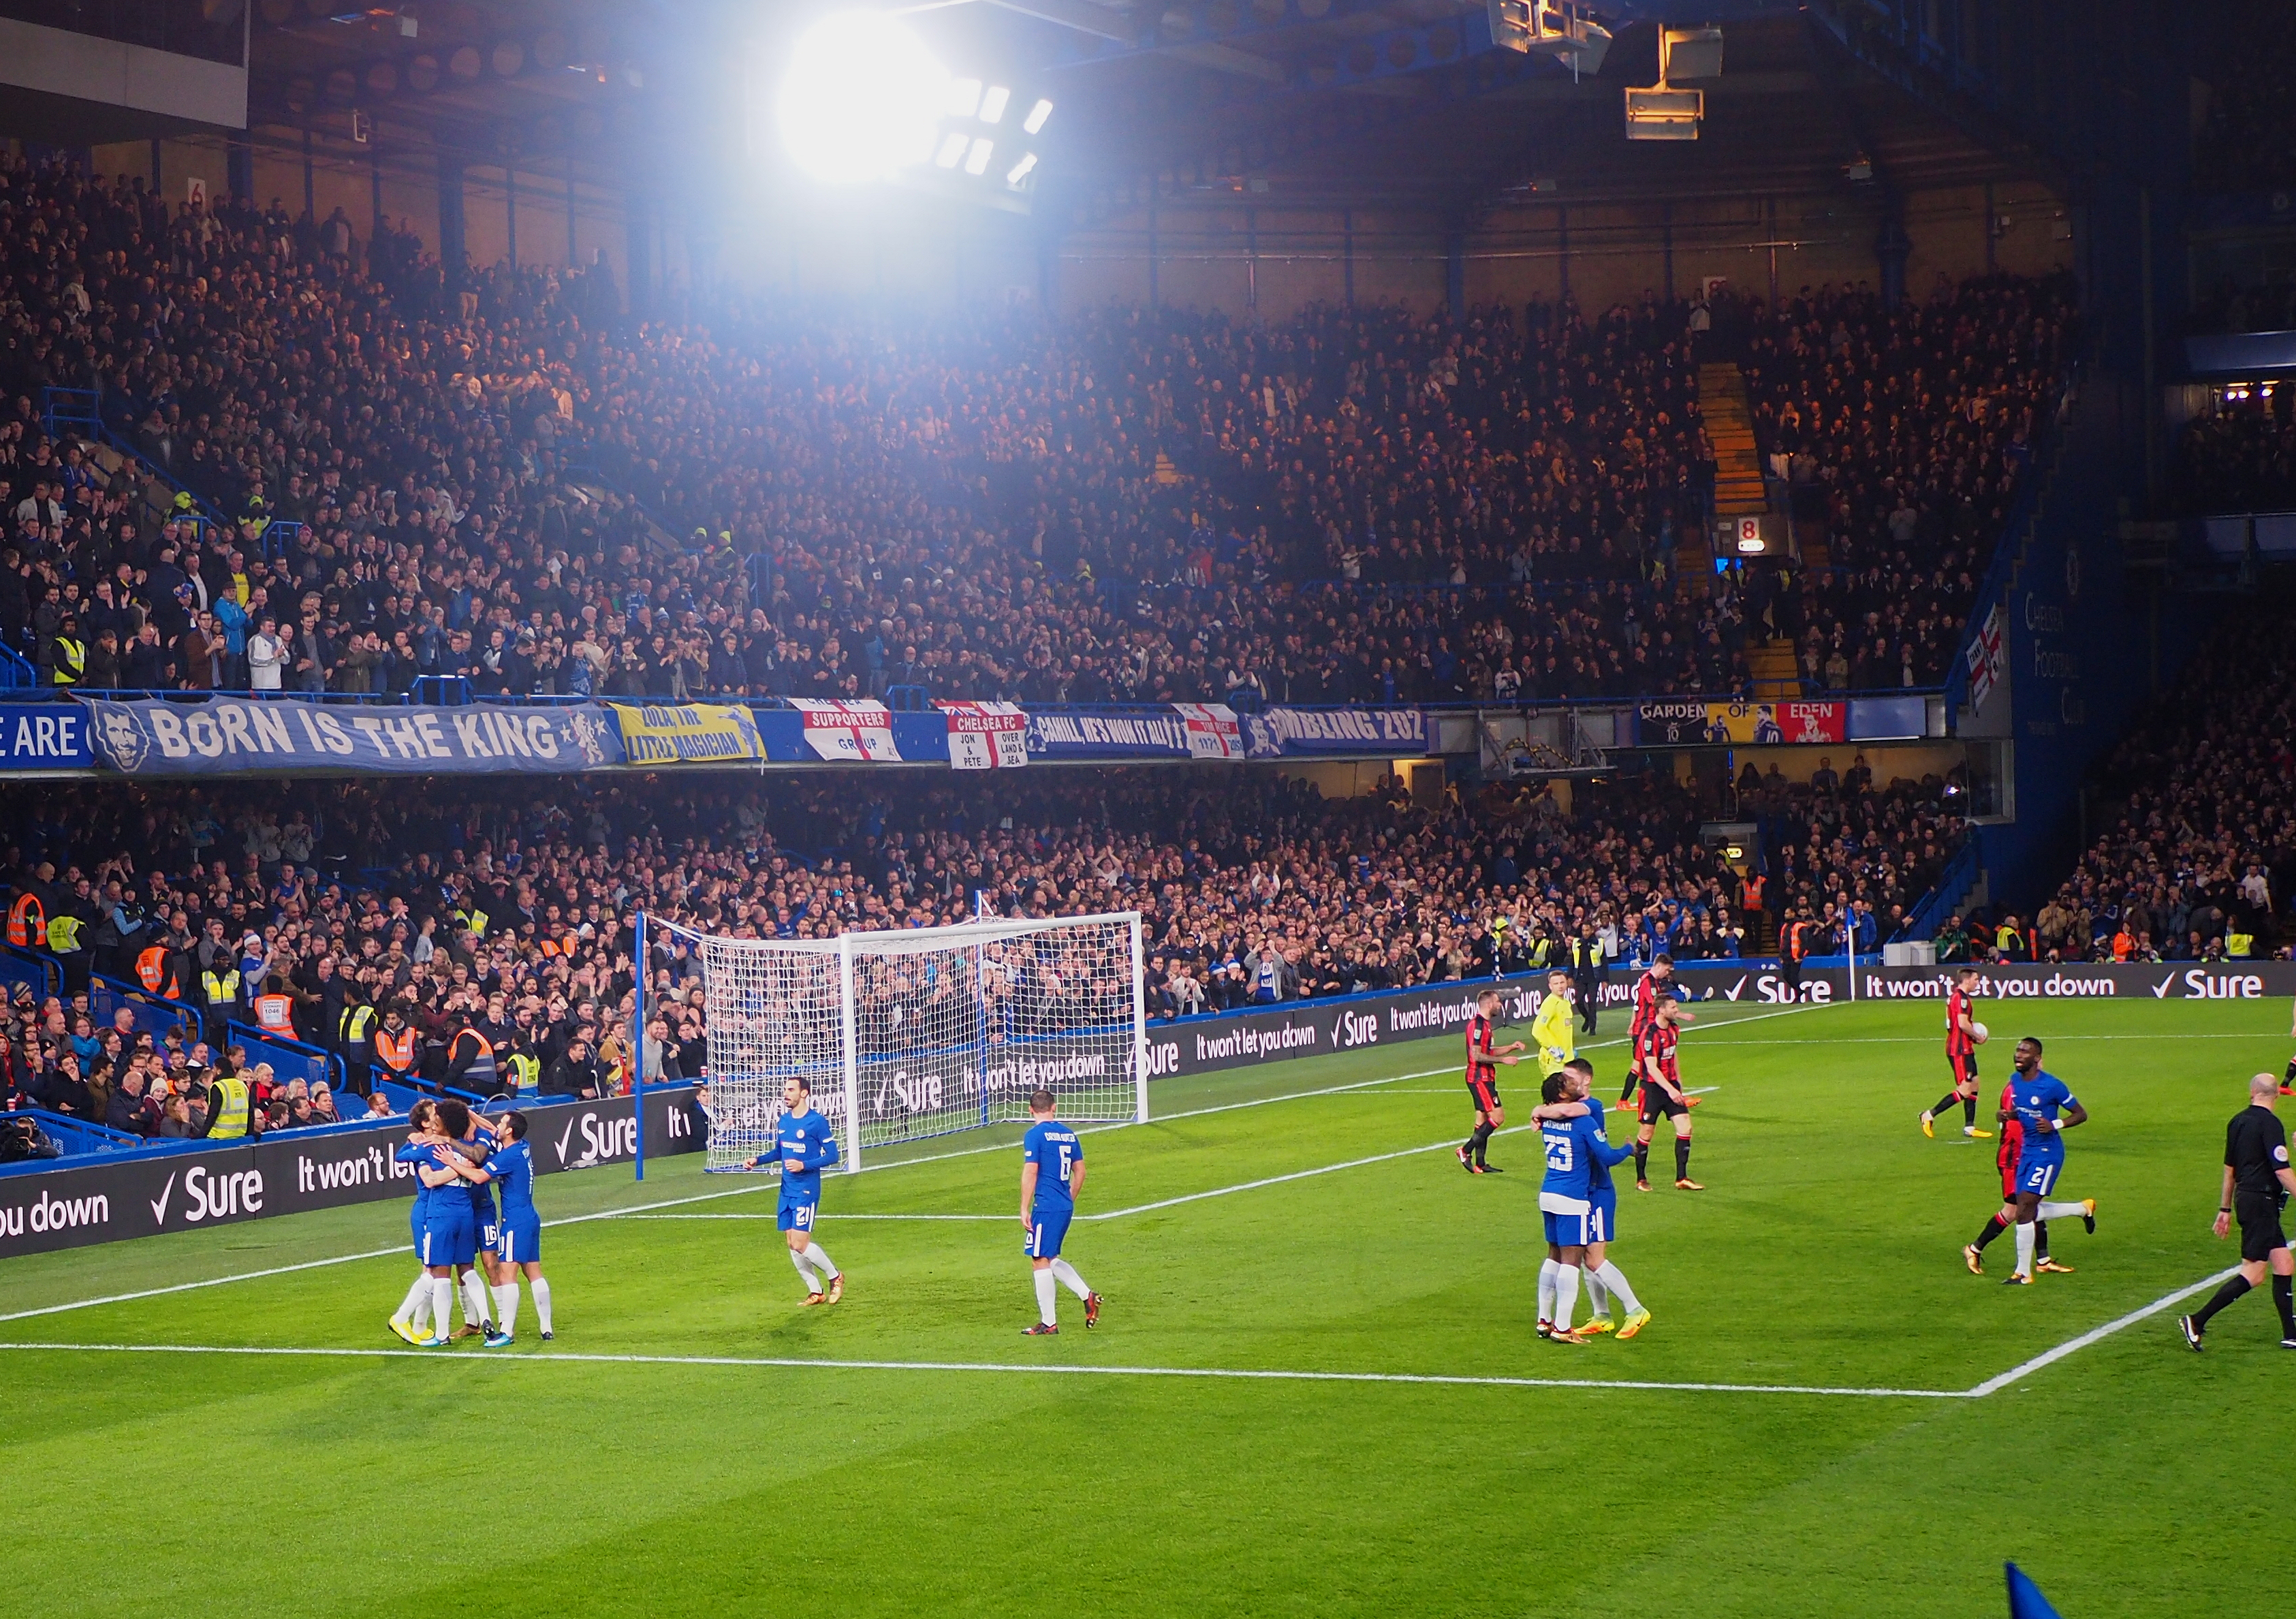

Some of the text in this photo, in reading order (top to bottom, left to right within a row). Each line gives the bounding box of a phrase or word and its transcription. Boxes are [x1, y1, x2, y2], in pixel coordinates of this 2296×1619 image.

[1742, 520, 1756, 539] 8
[812, 712, 885, 727] SUPPORTERS
[957, 716, 1016, 731] CHELSEA FC
[1374, 710, 1425, 740] 202
[1639, 703, 1832, 720] GARDEN OF EDEN
[14, 716, 78, 757] ARE
[149, 704, 295, 757] BORN
[297, 708, 353, 755] IS
[353, 712, 452, 759] THE
[452, 711, 560, 759] KING
[838, 738, 877, 751] GROUP
[960, 734, 975, 744] JON
[1002, 732, 1020, 742] OVER
[1104, 719, 1138, 744] WON
[1133, 720, 1149, 744] IT
[1666, 728, 1680, 742] 10
[1766, 730, 1780, 742] 10
[627, 732, 742, 761] LITTLE MAGICIAN
[966, 746, 973, 755] &
[1001, 743, 1024, 754] LAND &
[1007, 755, 1020, 765] SEA
[963, 757, 981, 767] PETE
[1604, 984, 1629, 1007] you
[1757, 975, 1831, 1004] Sure
[1866, 972, 2114, 1000] It won't et you down
[2185, 969, 2263, 999] Sure
[1344, 1011, 1377, 1047] Sure
[1390, 1007, 1399, 1032] It
[1398, 1002, 1428, 1030] won't
[1428, 1000, 1442, 1026] let
[1441, 1004, 1460, 1029] you
[1197, 1021, 1315, 1060] It won't let you down
[964, 1065, 975, 1094] It
[1018, 1056, 1037, 1086] let
[1038, 1059, 1065, 1090] you
[1065, 1049, 1105, 1079] down
[1144, 1037, 1180, 1078] Sure
[892, 1071, 943, 1112] Sure
[667, 1105, 682, 1138] It
[762, 1099, 788, 1133] yo
[581, 1112, 638, 1162] Sure
[1058, 1145, 1072, 1181] 6
[1543, 1133, 1573, 1172] 23
[298, 1155, 315, 1193] It
[317, 1146, 384, 1190] won't
[185, 1165, 264, 1222] Sure
[0, 1190, 109, 1238] u down
[796, 1206, 810, 1223] 21
[484, 1225, 497, 1242] 16
